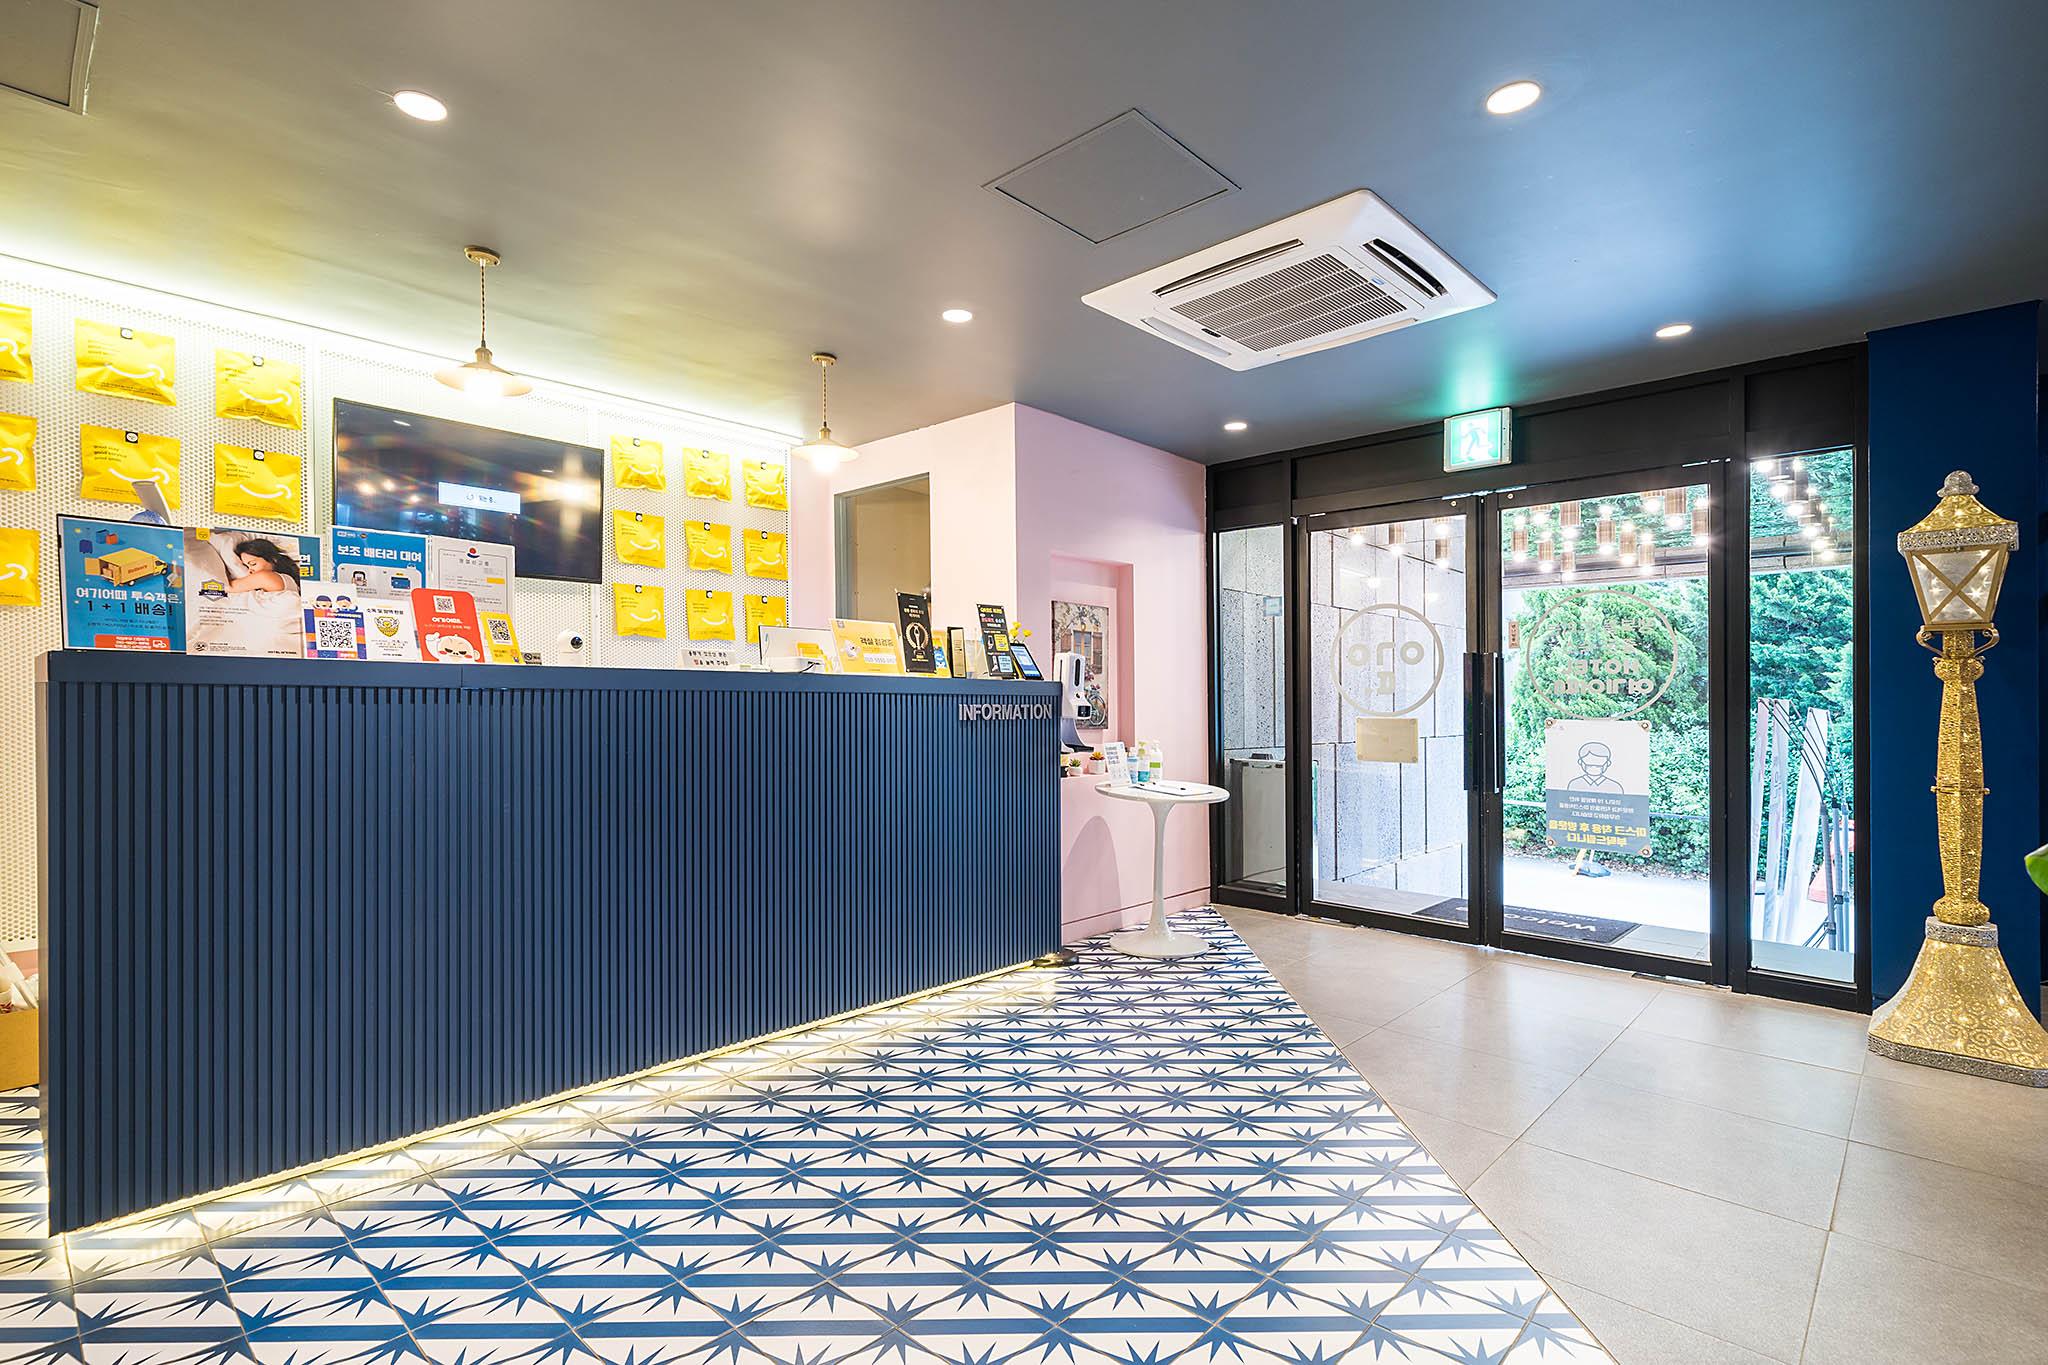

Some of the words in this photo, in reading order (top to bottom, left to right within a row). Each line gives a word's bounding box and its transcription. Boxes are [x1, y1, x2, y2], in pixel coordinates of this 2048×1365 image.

[337, 544, 361, 557] 보조
[363, 547, 398, 560] 배터리
[400, 550, 422, 563] 대여
[75, 586, 128, 601] 여기어때
[959, 703, 1052, 721] INFORMATION
